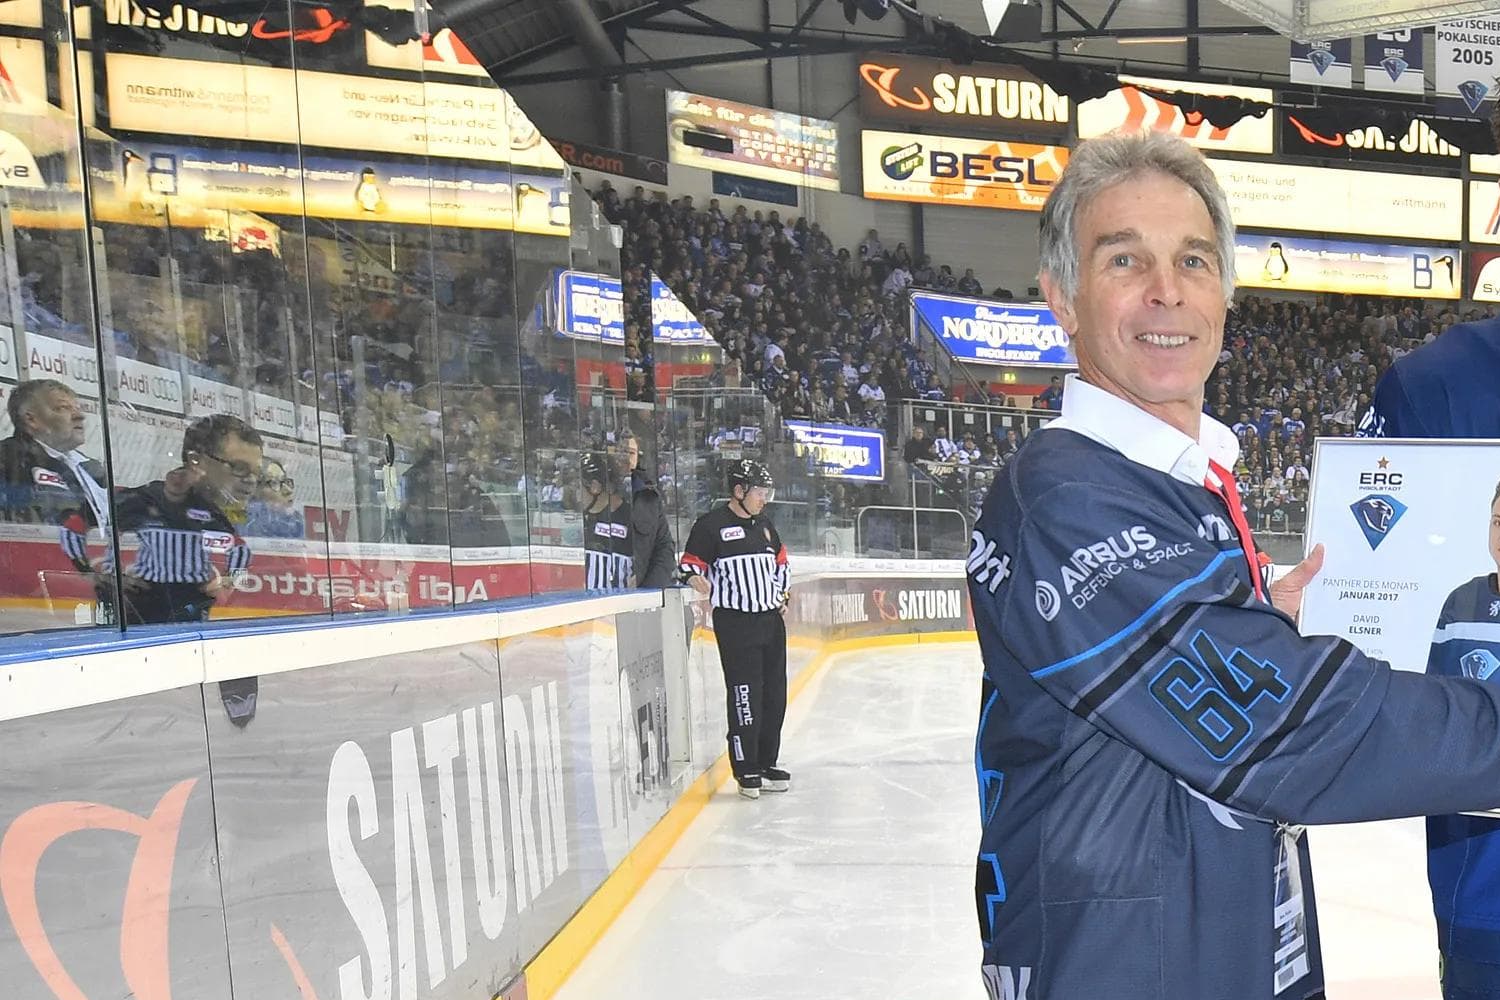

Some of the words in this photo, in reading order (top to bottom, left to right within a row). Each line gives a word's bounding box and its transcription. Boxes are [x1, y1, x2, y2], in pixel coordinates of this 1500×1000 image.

[1452, 48, 1494, 66] 2005
[932, 72, 1069, 124] SATURN
[1359, 472, 1403, 485] ERC
[1060, 525, 1157, 596] AIRBUS
[1323, 578, 1359, 589] PANTHER
[1360, 579, 1378, 589] DES
[1379, 580, 1419, 591] MONATS
[1338, 591, 1376, 601] JANUAR
[1378, 592, 1399, 602] 2017
[898, 590, 961, 621] SATURN
[1352, 614, 1380, 624] DAVID
[1348, 625, 1382, 636] ELSNER
[1147, 629, 1292, 763] 64
